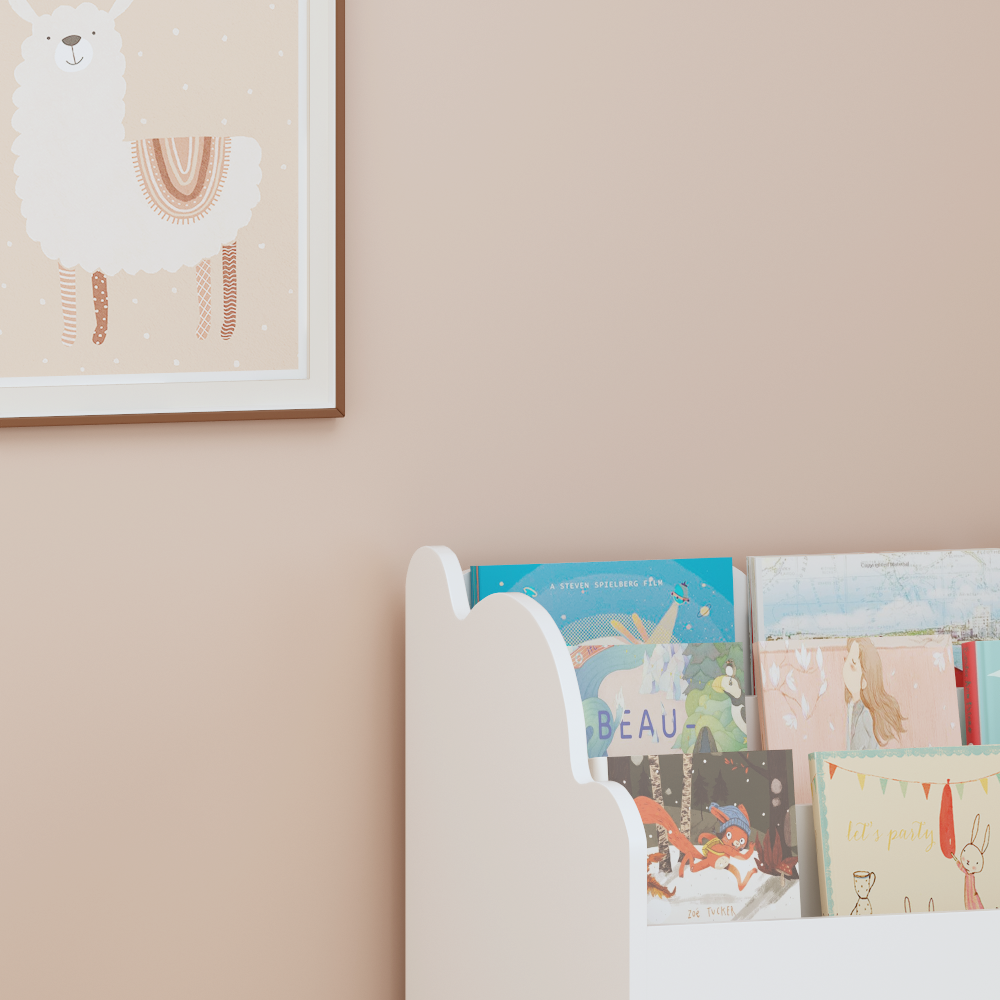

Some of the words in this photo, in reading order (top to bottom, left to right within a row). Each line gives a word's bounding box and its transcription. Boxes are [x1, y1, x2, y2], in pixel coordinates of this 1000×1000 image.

[560, 582, 590, 590] STEVEN
[594, 580, 639, 589] SPIELBERG
[643, 579, 664, 587] FILM
[846, 820, 883, 843] let's
[887, 820, 936, 853] party
[706, 905, 738, 918] TUCKER
